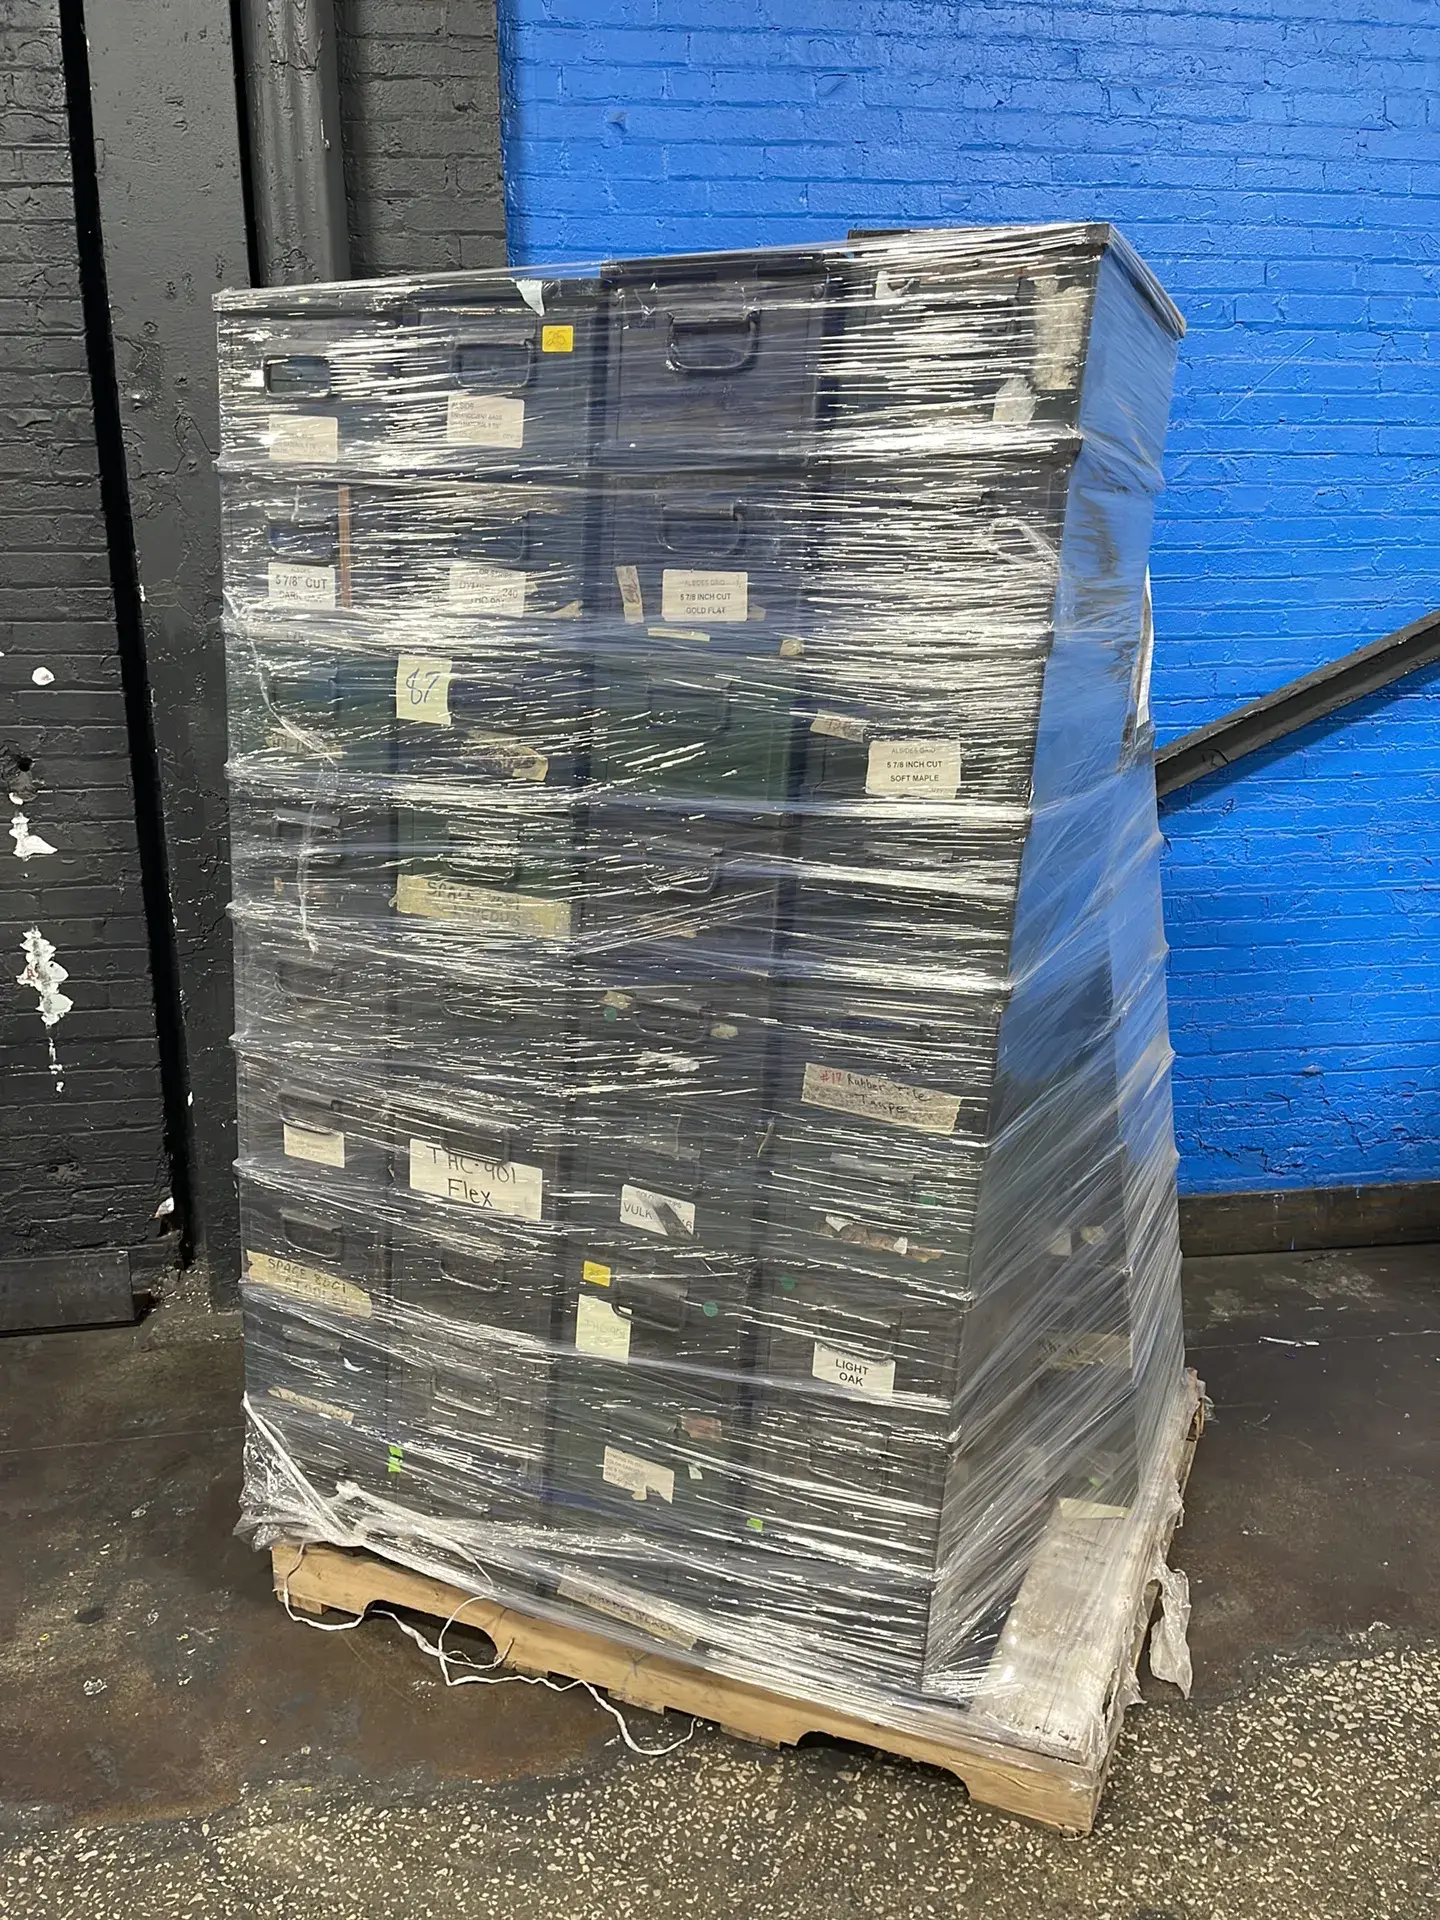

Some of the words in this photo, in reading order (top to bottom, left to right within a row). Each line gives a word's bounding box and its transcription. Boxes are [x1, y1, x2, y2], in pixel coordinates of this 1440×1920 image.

[275, 574, 281, 585] 5
[305, 578, 328, 589] CUT
[502, 588, 518, 599] 240
[406, 668, 441, 705] 87
[912, 774, 939, 782] MAPLE
[448, 1178, 493, 1207] Flex
[268, 1258, 306, 1276] SPACE
[835, 1359, 869, 1376] LIGHT
[839, 1372, 864, 1387] OAK
